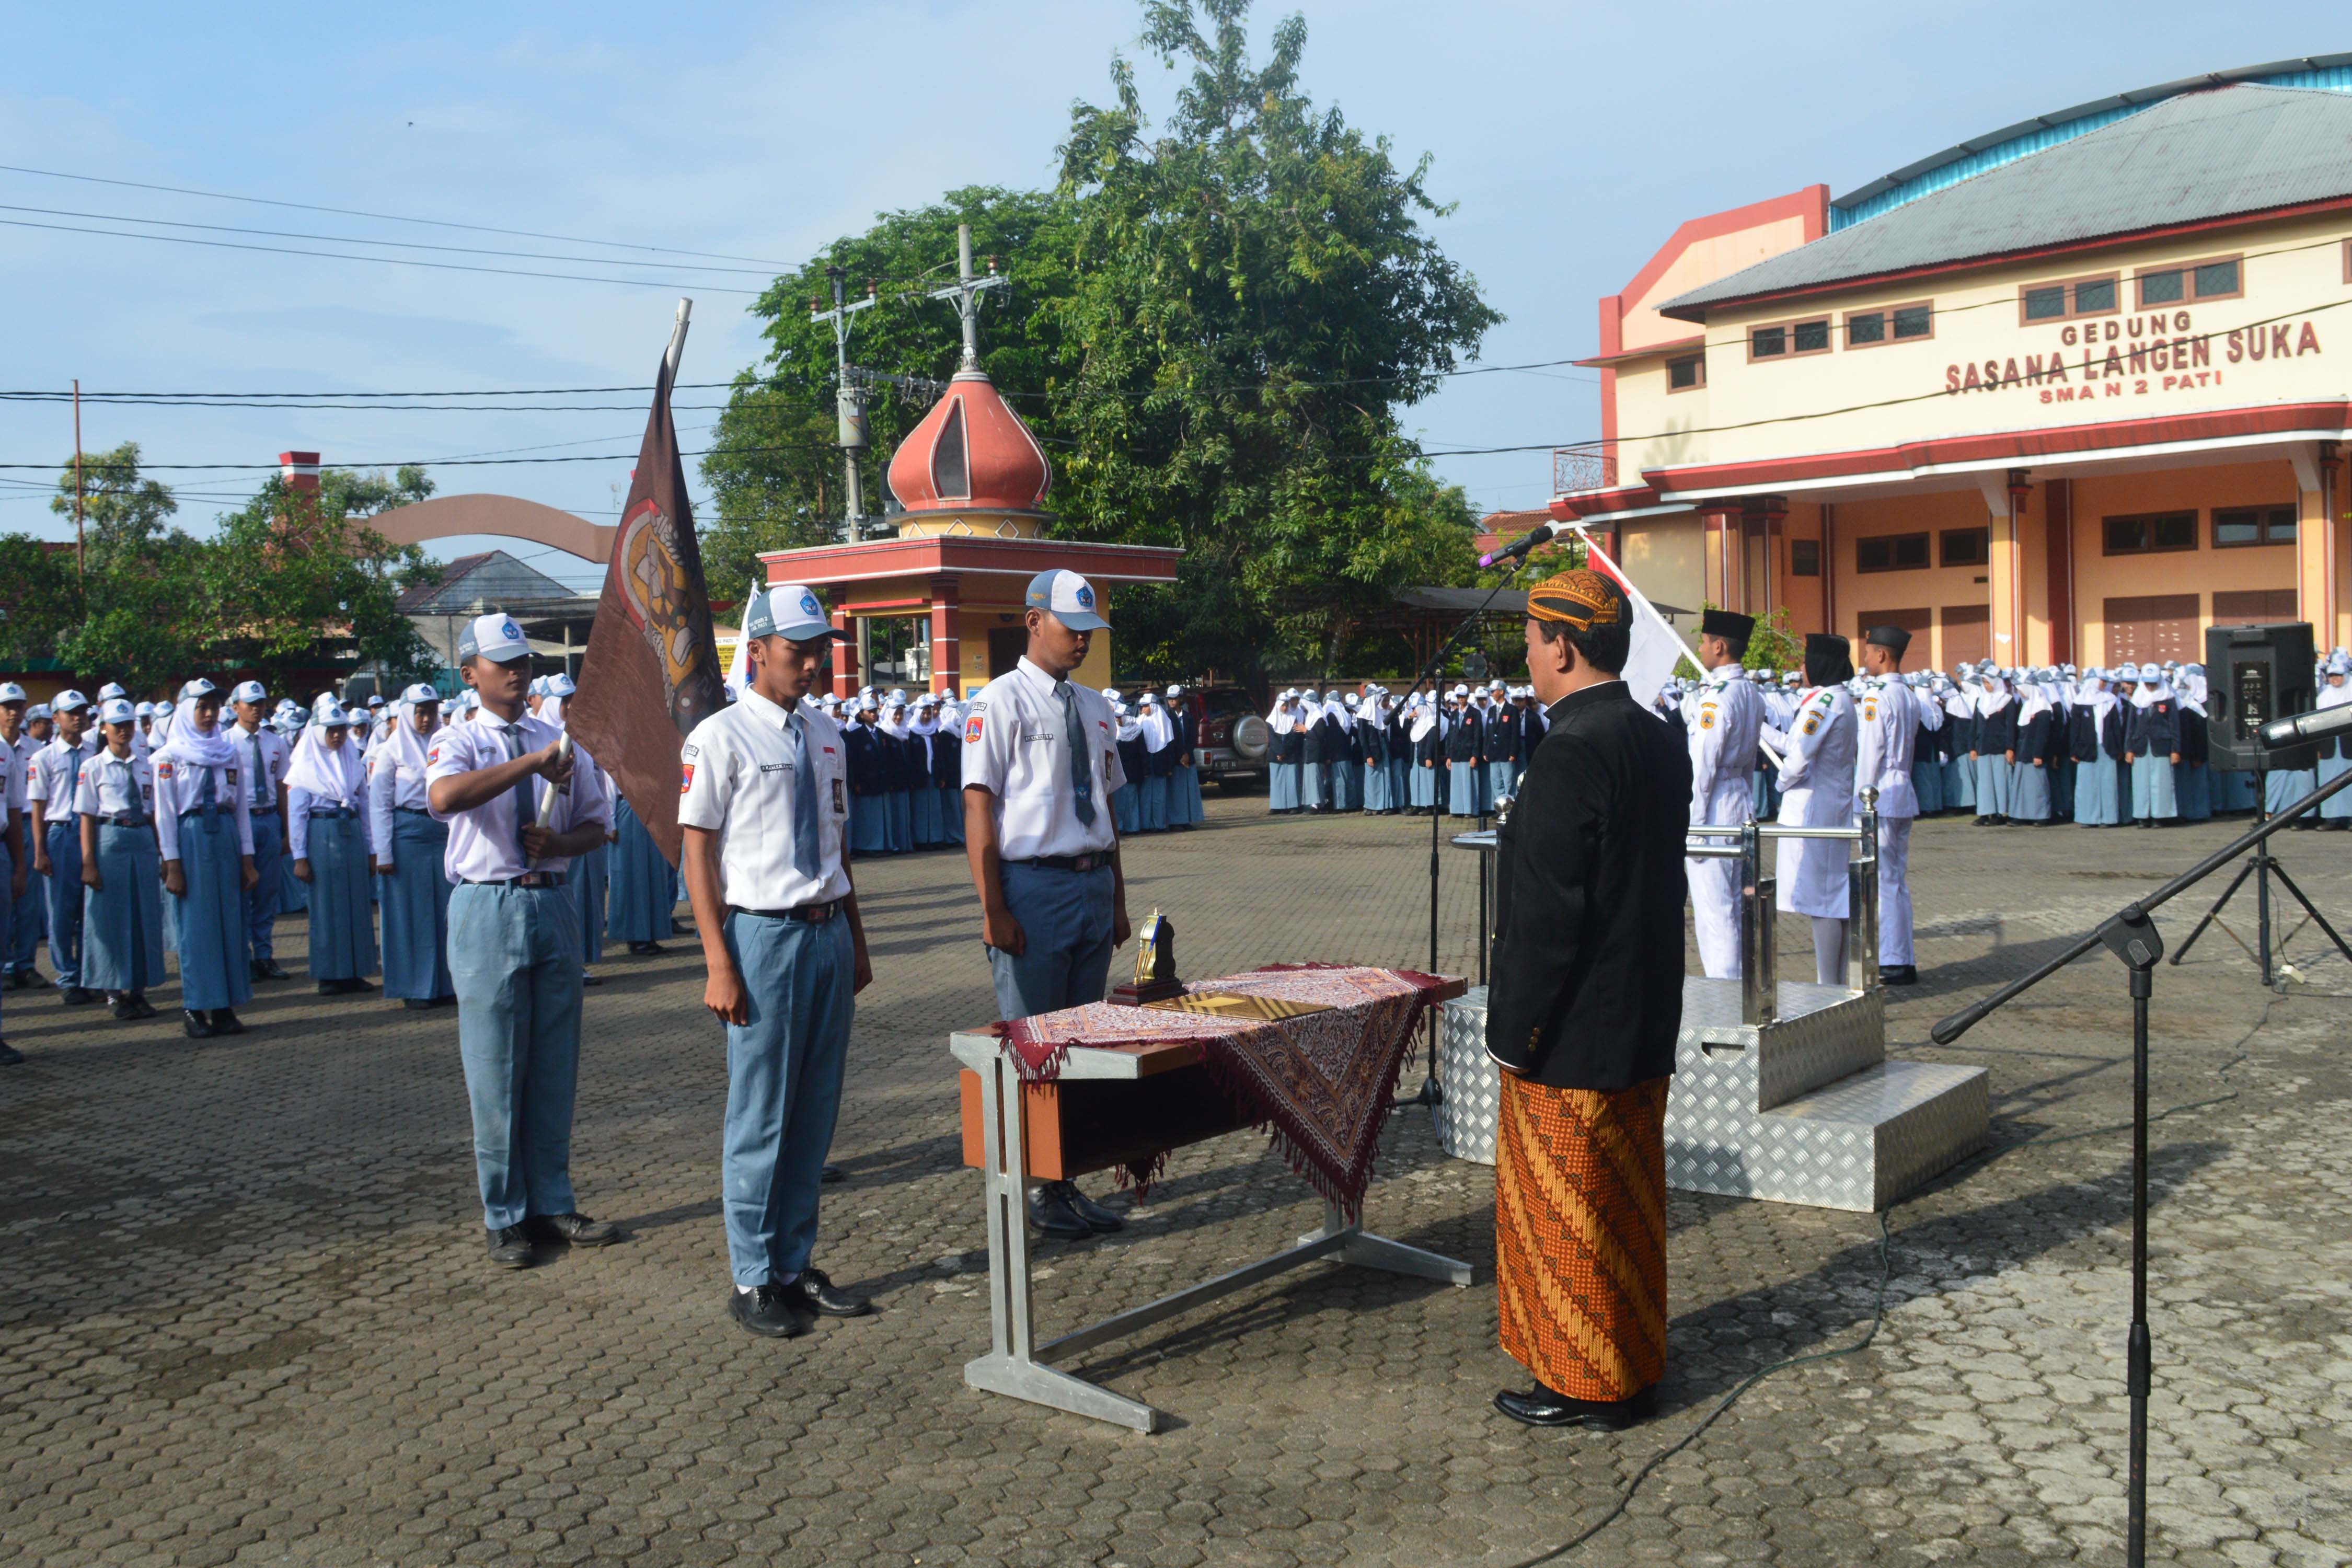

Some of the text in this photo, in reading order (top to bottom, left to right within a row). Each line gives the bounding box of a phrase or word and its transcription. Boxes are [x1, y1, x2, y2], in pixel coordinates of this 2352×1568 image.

[2061, 310, 2190, 346] GEDUNG
[1945, 321, 2321, 396] SASANA LANGEN SUKA
[2039, 370, 2221, 404] SMA N 2 PATI
